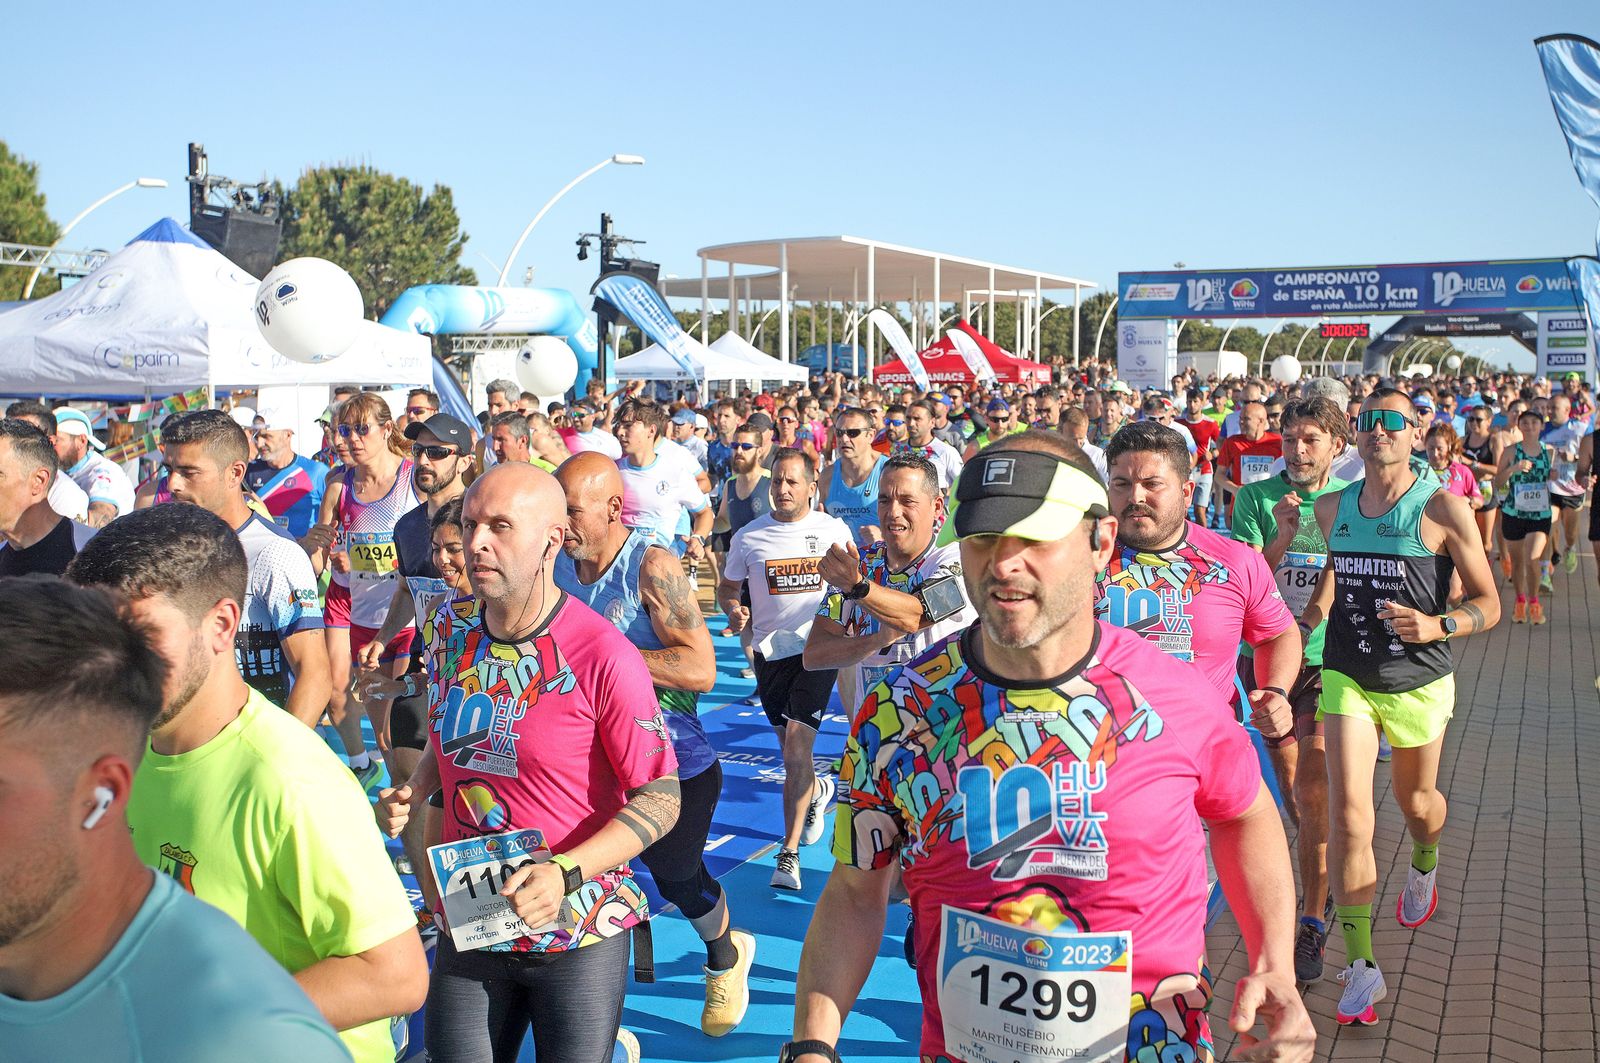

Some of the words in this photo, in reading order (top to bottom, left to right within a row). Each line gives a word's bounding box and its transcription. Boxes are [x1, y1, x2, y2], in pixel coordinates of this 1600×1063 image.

[1274, 271, 1380, 286] CAMPEONATO
[1461, 277, 1506, 291] HUELVA
[1272, 290, 1289, 301] de
[1293, 286, 1346, 300] ESPAÑA
[1354, 284, 1379, 301] 10
[1385, 283, 1418, 300] km
[1342, 302, 1378, 310] Absoluto
[1388, 300, 1418, 308] Master
[878, 372, 965, 382] SPORTANIACS
[1248, 464, 1268, 472] 1578
[1524, 491, 1541, 500] 826
[355, 545, 394, 560] 1294
[776, 573, 821, 586] ENDURO
[419, 592, 434, 608] 16
[495, 695, 527, 720] HU
[492, 715, 520, 740] EL
[490, 733, 517, 757] VA
[472, 760, 516, 777] DESCUBRIMIENTO
[487, 755, 506, 766] PUERTA
[506, 760, 516, 768] DEL
[1056, 791, 1108, 820] EL
[957, 764, 1053, 870] 10
[1053, 760, 1107, 793] HU
[1055, 819, 1108, 849] VA
[506, 835, 540, 854] 2023
[457, 847, 484, 860] HUELVA
[1054, 852, 1087, 865] PUERTA
[1089, 854, 1106, 868] DEL
[459, 858, 537, 900] 110
[1029, 864, 1106, 880] DESCUBRIMIENTO
[476, 902, 504, 912] VICTOR
[956, 917, 980, 954] 10
[979, 930, 1018, 953] HUELVA
[1025, 956, 1048, 968] WiHu
[1062, 945, 1112, 966] 2023
[970, 964, 1096, 1023] 1299
[1003, 1023, 1056, 1042] EUSEBIO
[972, 1027, 1013, 1048] MARTÍN
[1016, 1041, 1090, 1058] FERNÁNDEZ
